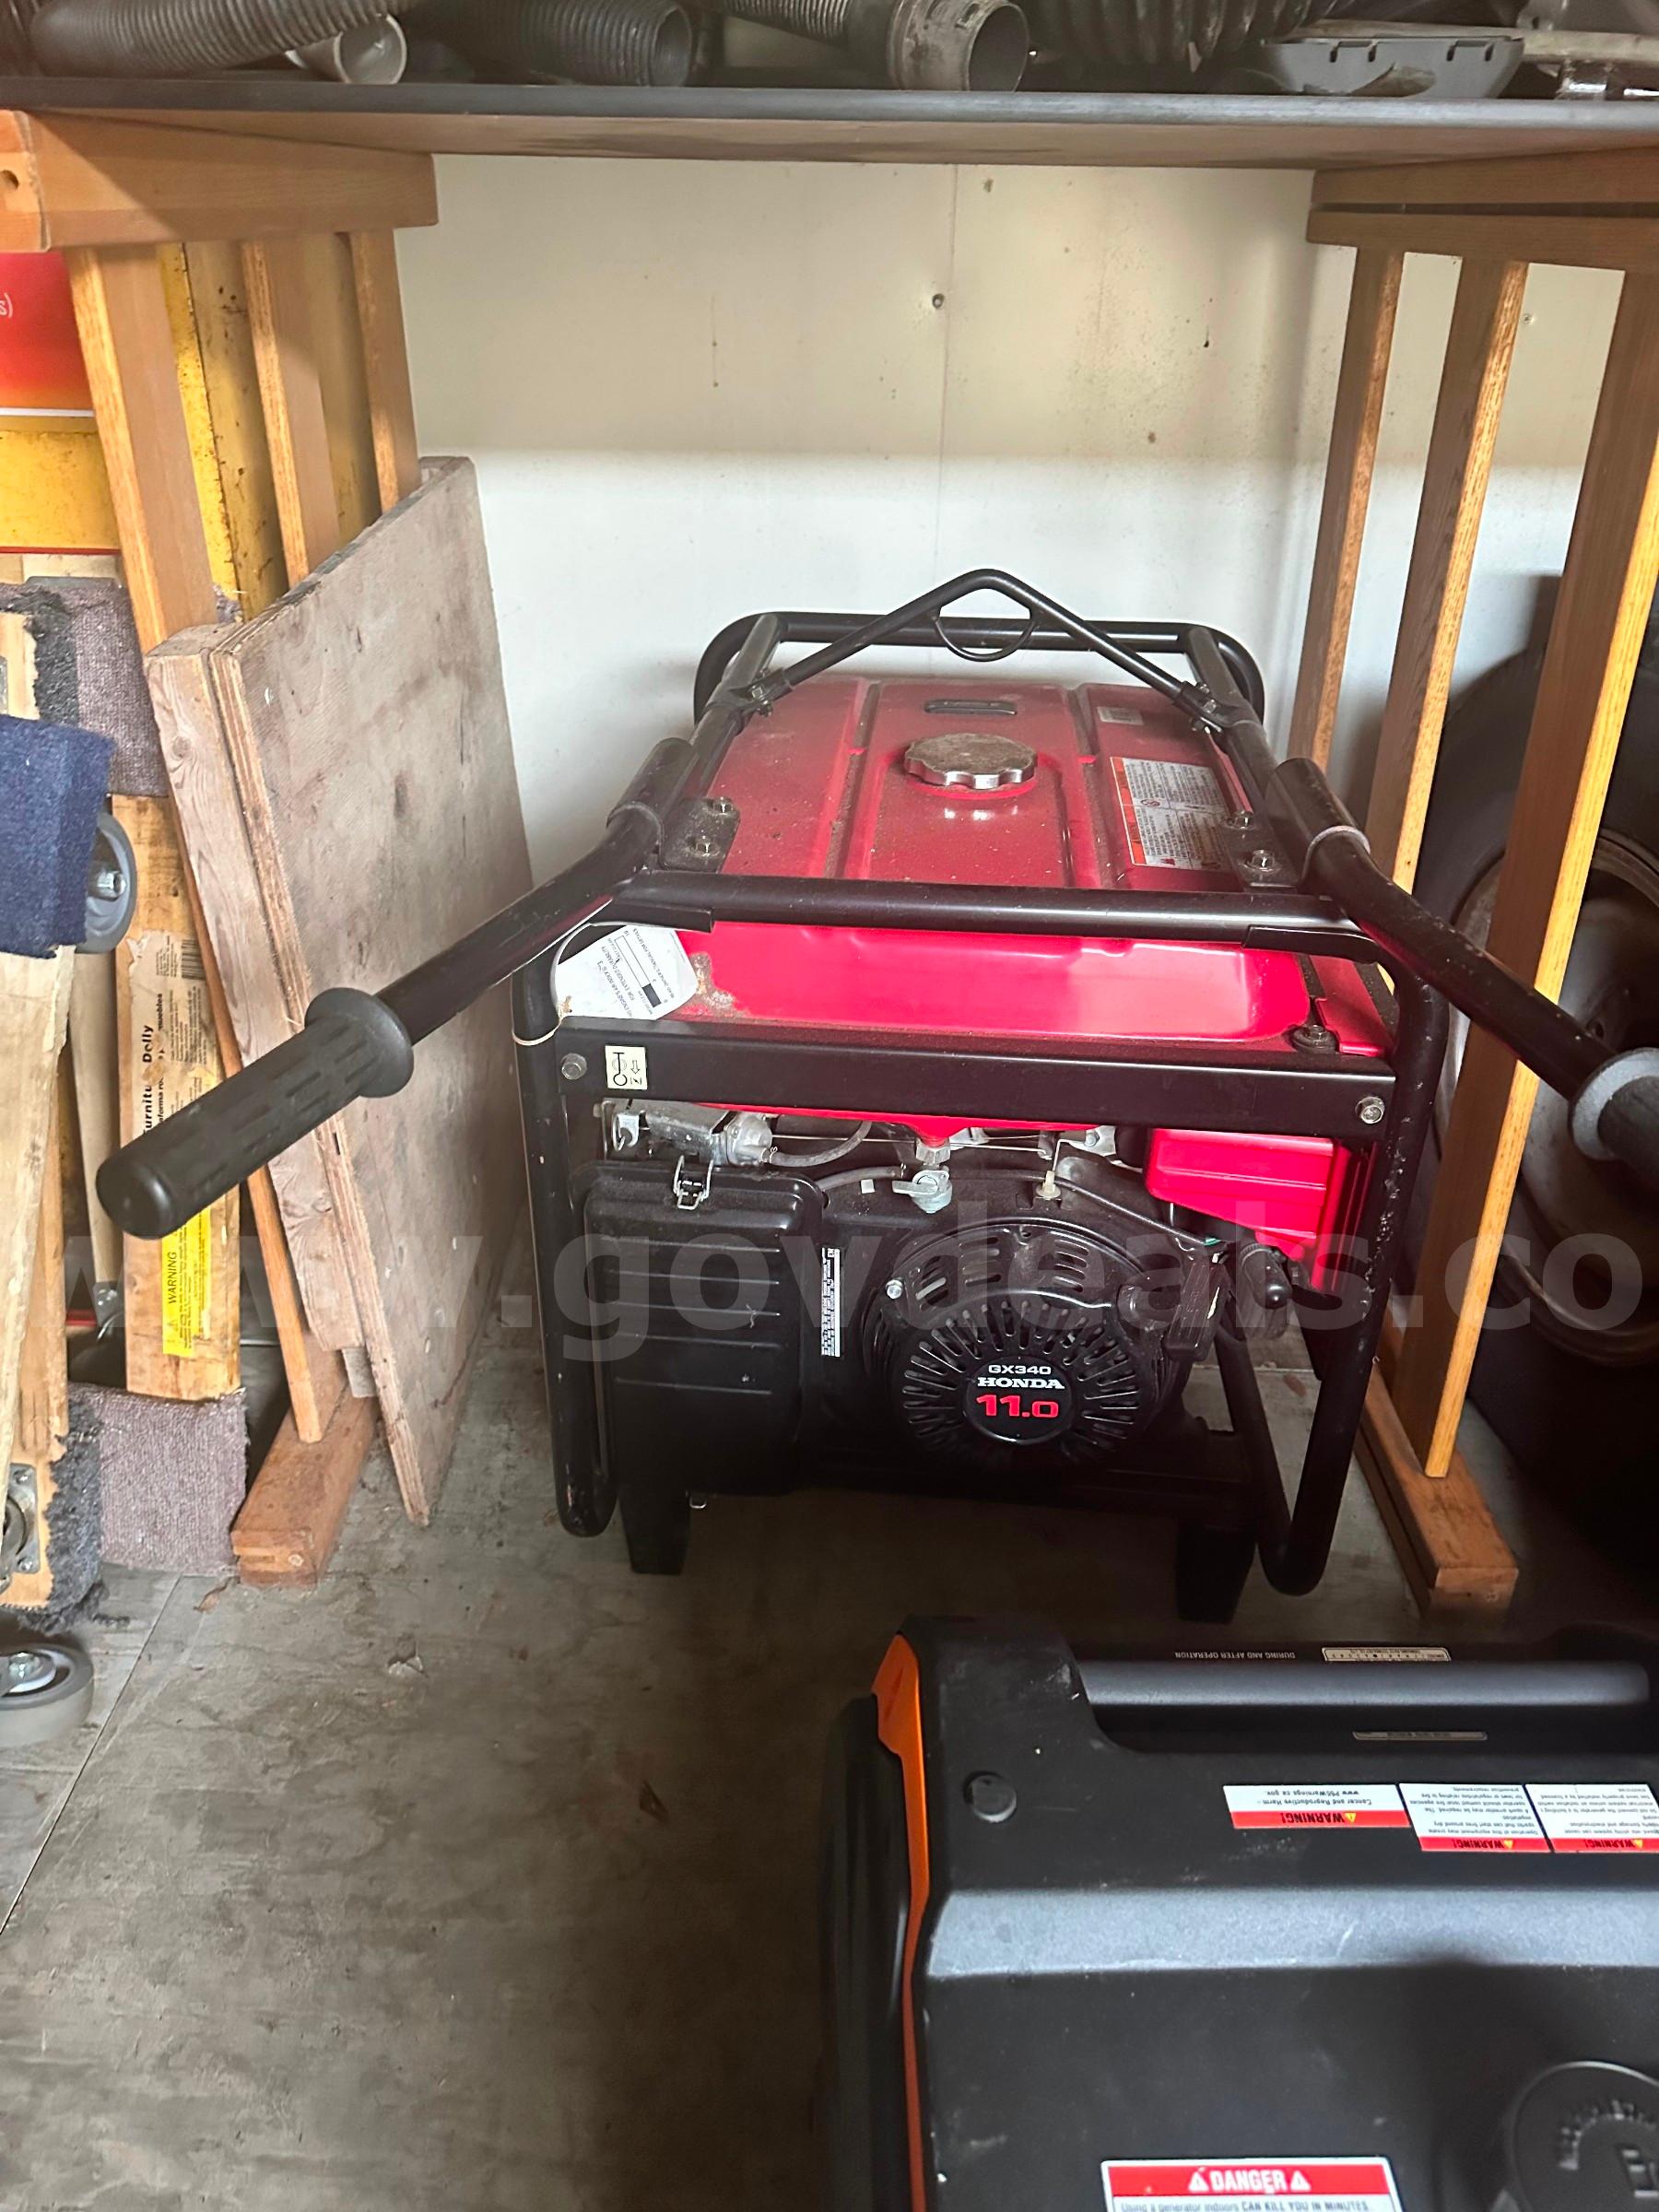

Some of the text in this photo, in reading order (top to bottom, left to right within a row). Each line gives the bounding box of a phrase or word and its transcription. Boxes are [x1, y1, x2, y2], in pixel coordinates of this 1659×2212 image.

[168, 1252, 177, 1303] WARNING
[988, 1365, 1052, 1374] GX340
[977, 1377, 1065, 1390] HONDA
[976, 1394, 1059, 1418] 11.0
[1280, 1813, 1345, 1823] WARNING!
[1453, 1840, 1504, 1848] WARNING!
[1584, 1840, 1634, 1848] WARNING!
[1209, 2171, 1288, 2191] DANGER
[1242, 2201, 1262, 2211] CAN
[1265, 2201, 1285, 2211] KILL
[1288, 2201, 1309, 2211] YOU
[1312, 2201, 1322, 2211] IN
